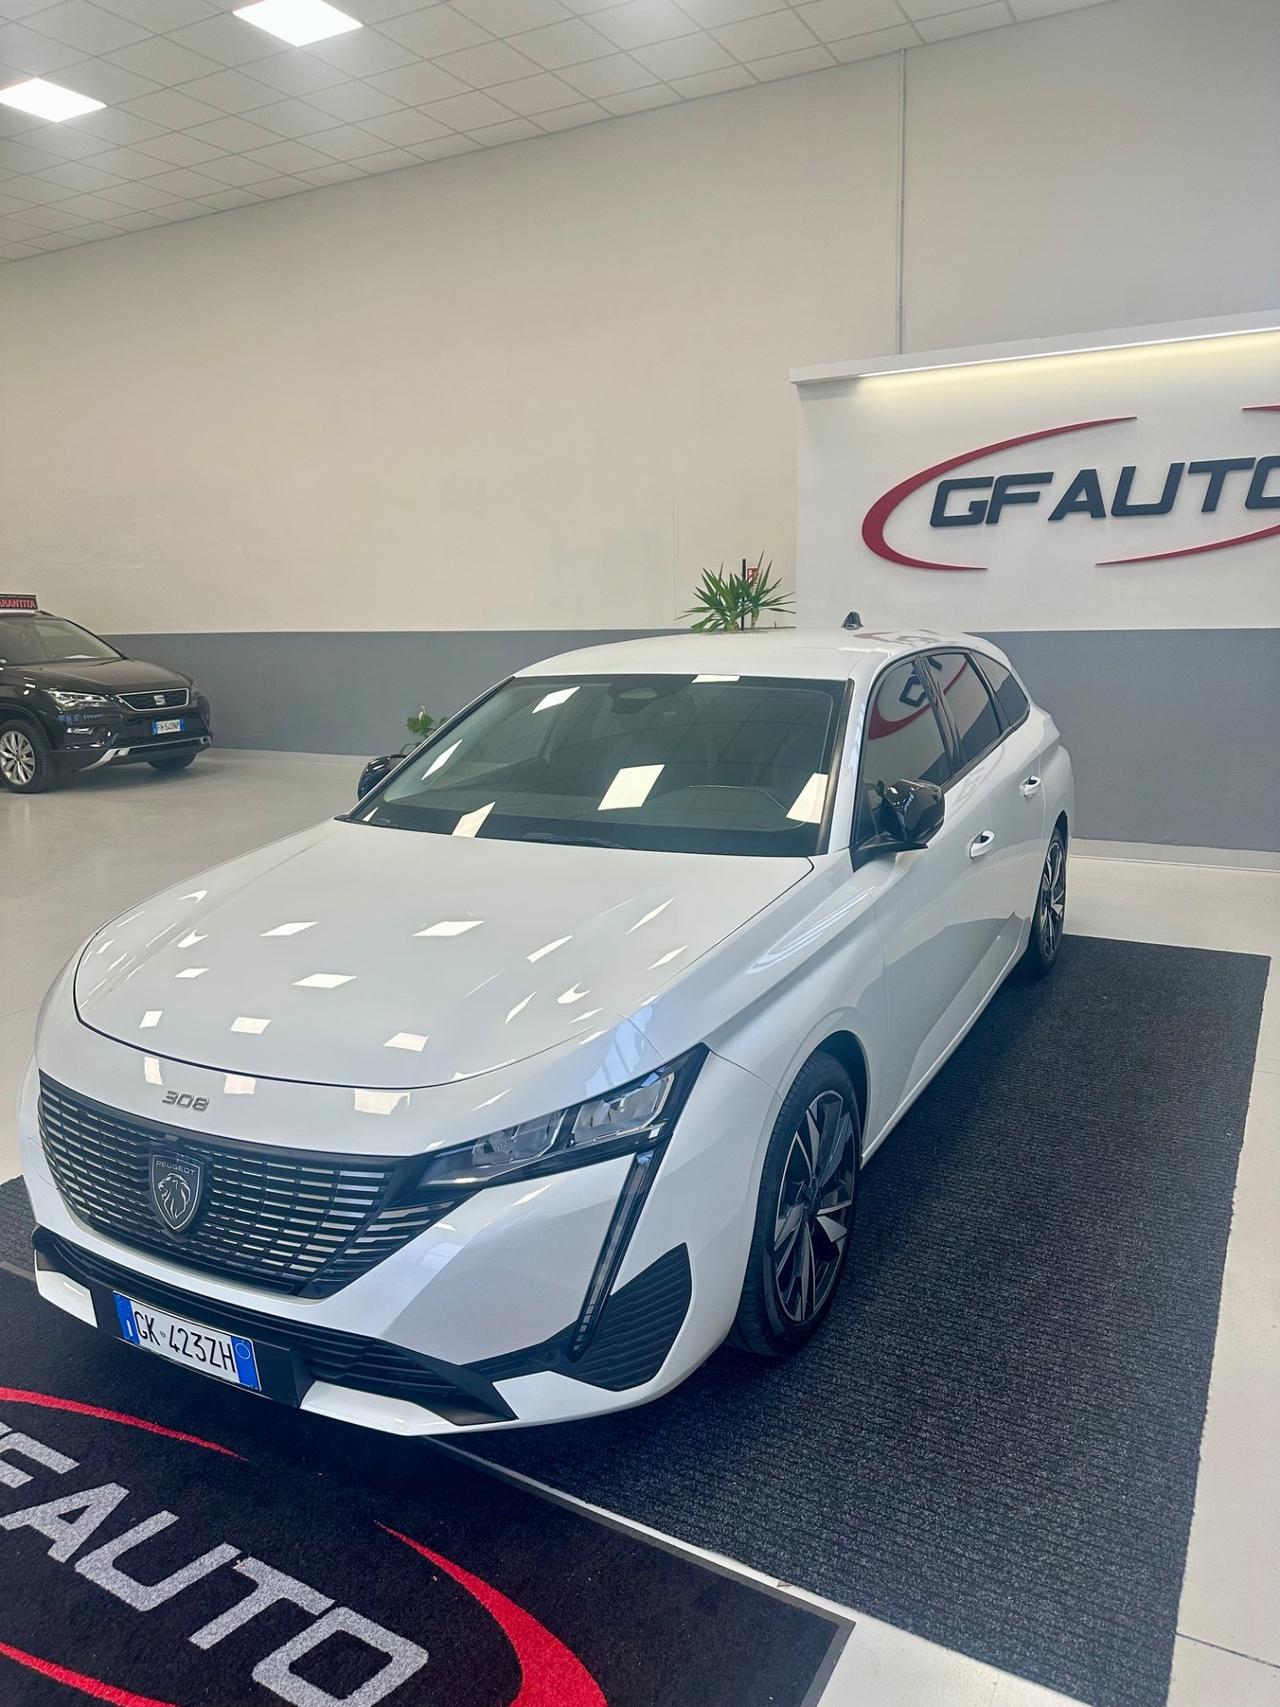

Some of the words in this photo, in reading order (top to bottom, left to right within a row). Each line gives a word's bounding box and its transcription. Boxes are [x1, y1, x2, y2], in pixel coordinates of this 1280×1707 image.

[930, 471, 1054, 528] GF
[161, 1090, 210, 1112] 308
[155, 1160, 197, 1176] PEUGEOT
[0, 1482, 430, 1707] AUTO
